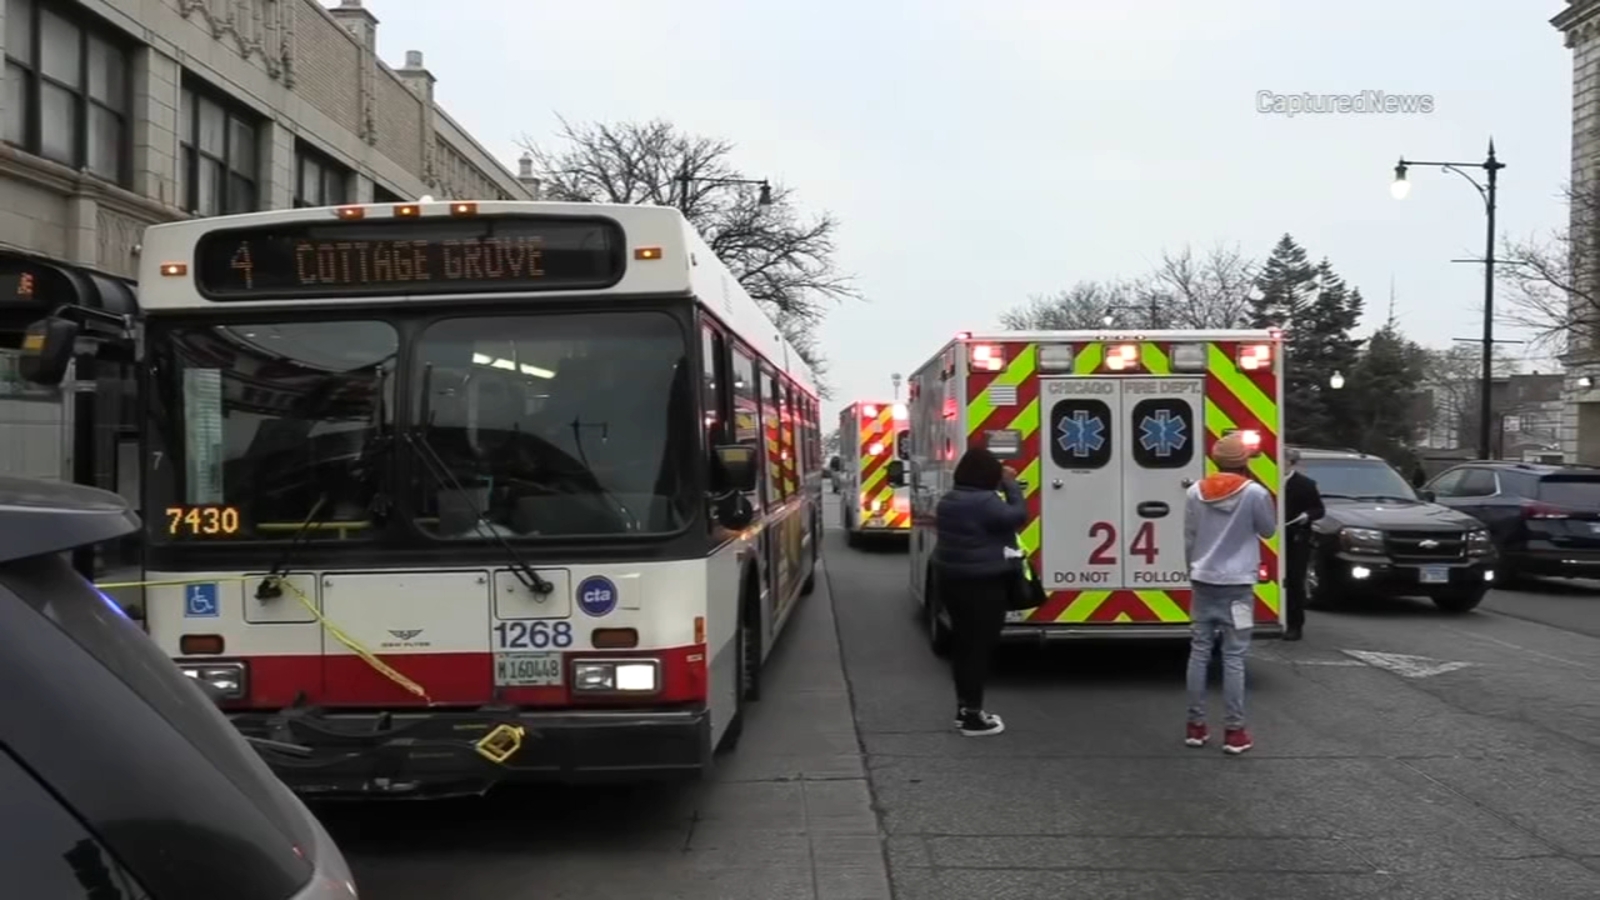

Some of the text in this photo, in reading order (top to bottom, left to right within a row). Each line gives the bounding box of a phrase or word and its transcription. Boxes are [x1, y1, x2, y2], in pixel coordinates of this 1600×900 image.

[230, 236, 545, 289] 4 COTTAGE GROVE
[1048, 381, 1113, 395] CHICAGO
[1124, 381, 1157, 395] FIRE
[165, 507, 239, 534] 7430
[1054, 571, 1076, 584] DO
[1079, 571, 1110, 584] NOT
[583, 588, 611, 602] cta
[494, 620, 573, 649] 1268
